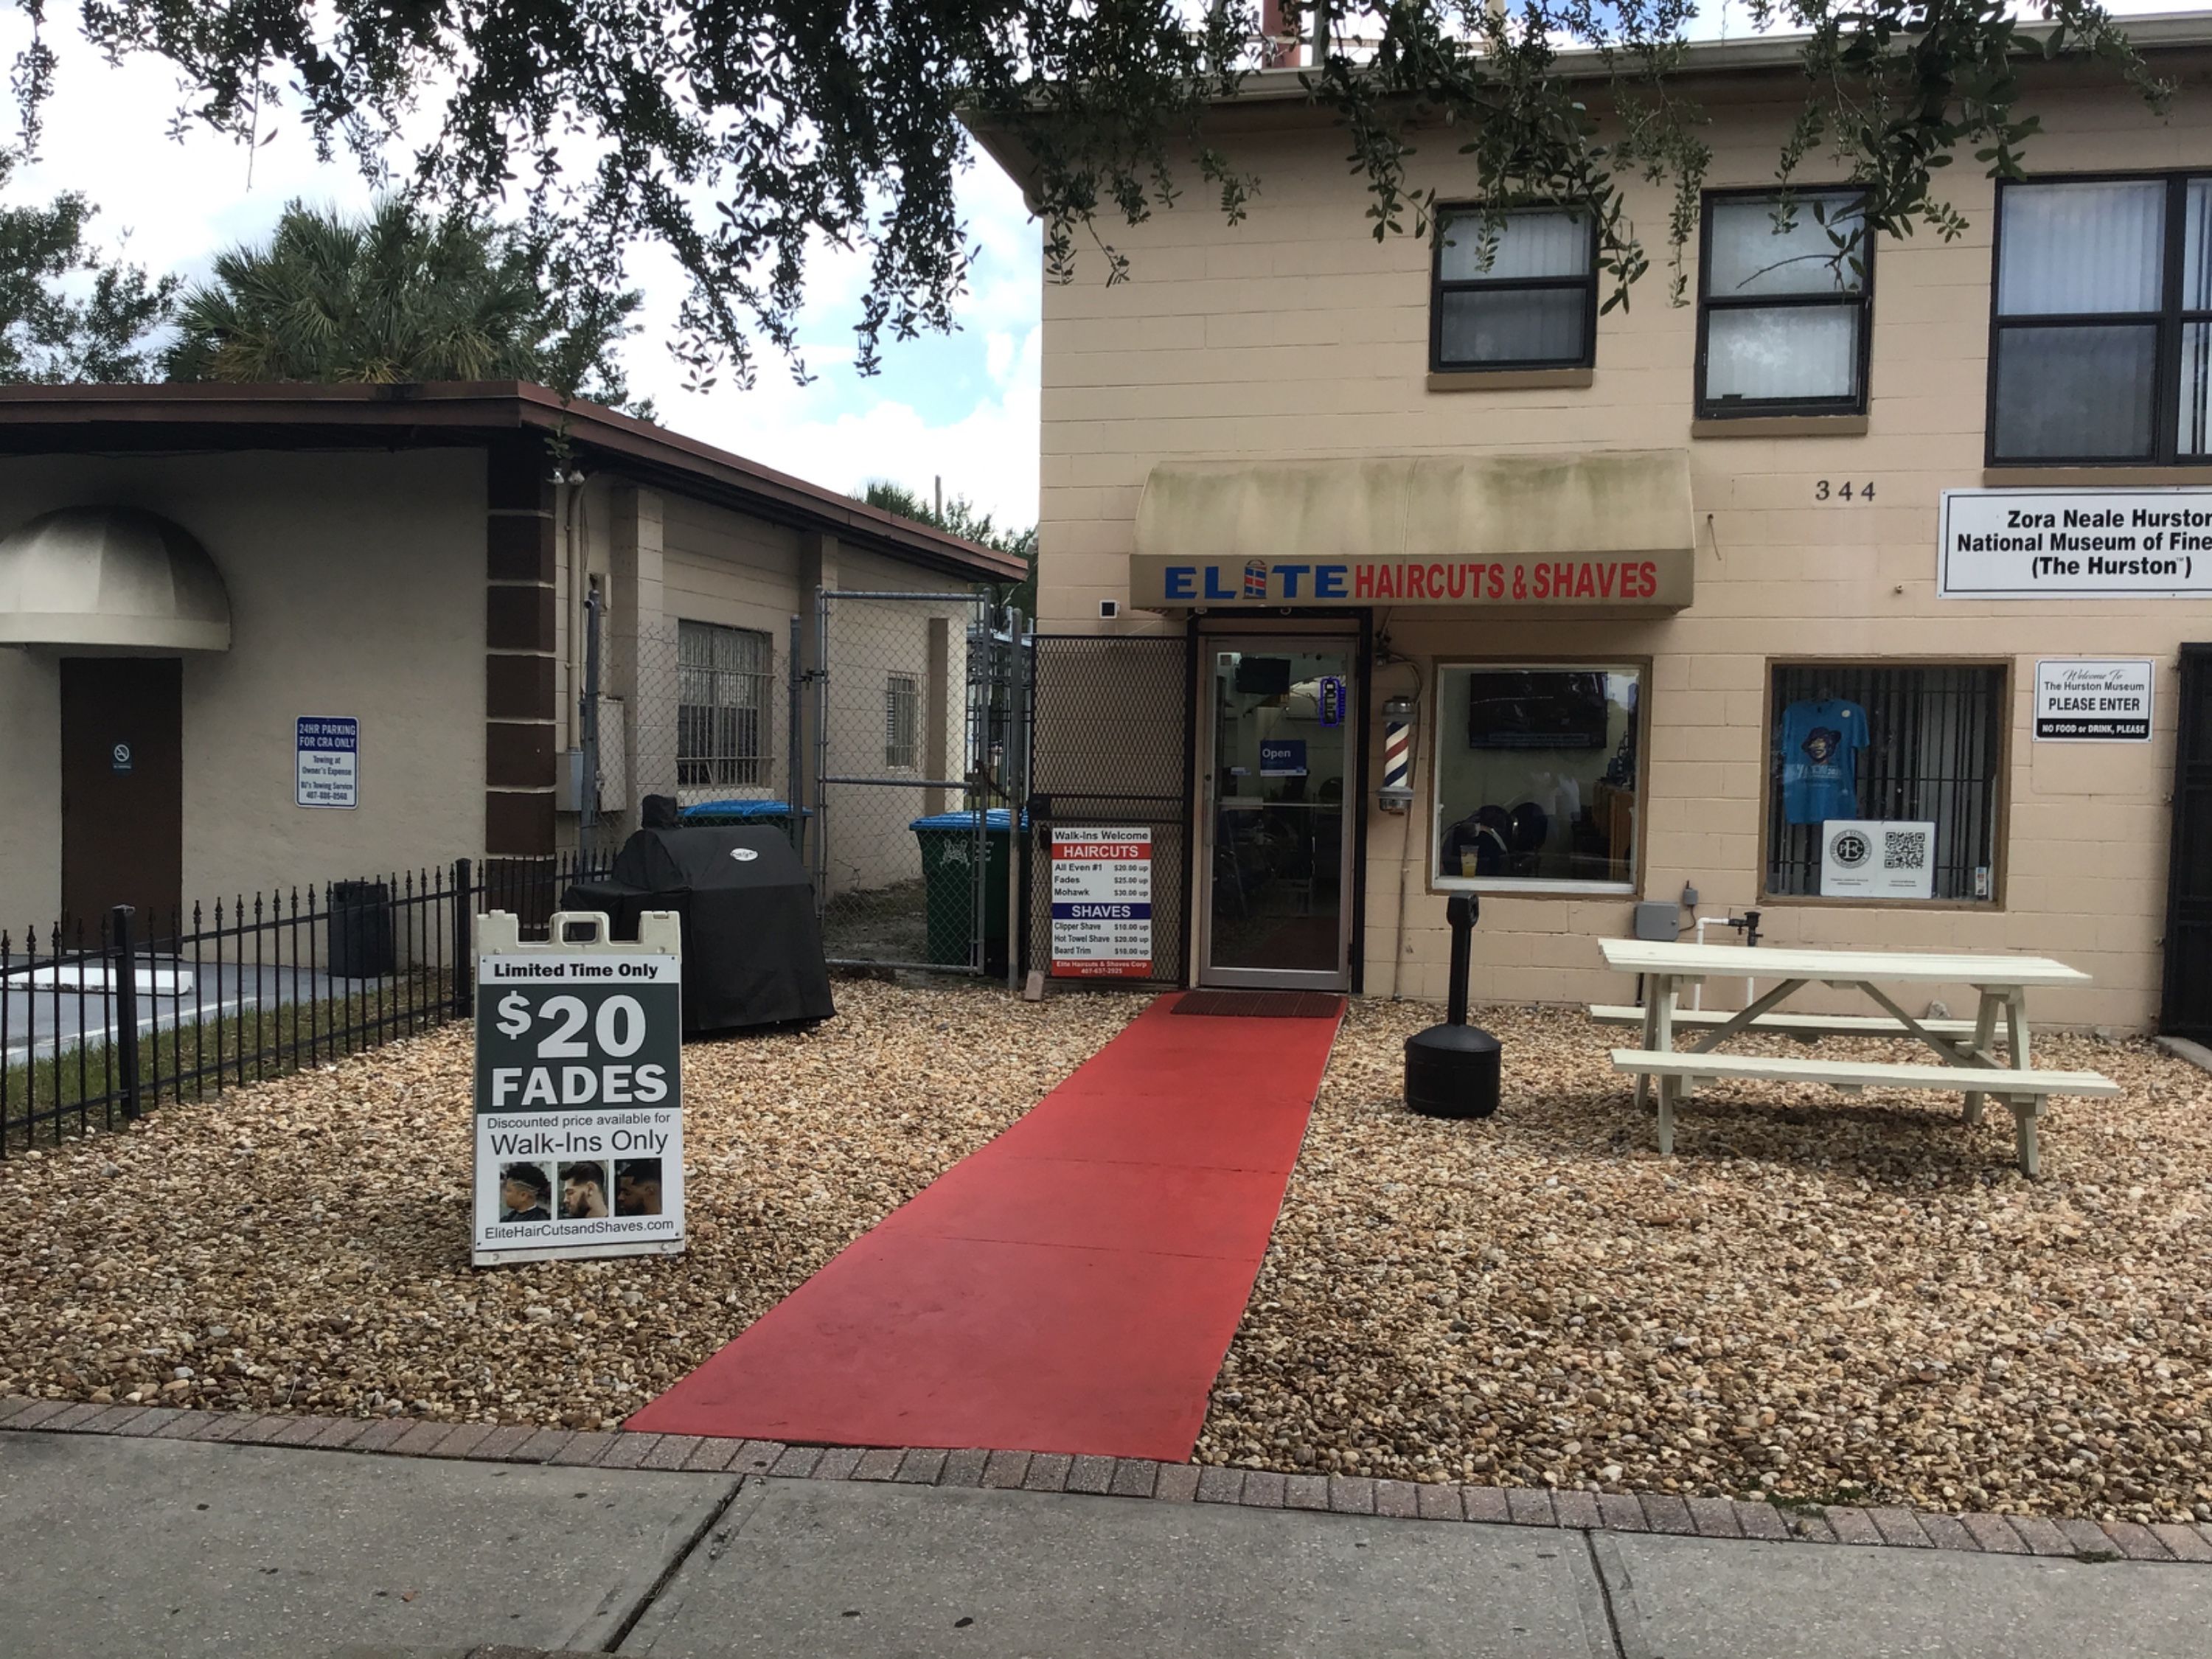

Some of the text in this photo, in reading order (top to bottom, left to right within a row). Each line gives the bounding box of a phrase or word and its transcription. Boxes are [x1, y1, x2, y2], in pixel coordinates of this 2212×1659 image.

[1815, 480, 1876, 501] 344
[2007, 510, 2055, 528] Zora
[2063, 509, 2124, 528] Neale
[1957, 531, 2212, 552] National Museum of Fine
[2032, 557, 2080, 578] (The
[1355, 563, 1504, 599] HAIRCUTS
[1512, 565, 1527, 599] &
[1533, 561, 1657, 598] SHAVES
[2062, 669, 2126, 681] Welcome To
[2044, 681, 2145, 691] The Hurston Museum
[2049, 698, 2140, 711] PLEASE ENTER
[299, 723, 355, 735] 24HR PARKING
[2042, 725, 2054, 733] NO
[2056, 725, 2077, 733] FOOD
[2088, 725, 2115, 734] DRINK,
[2116, 725, 2146, 734] PLEASE
[299, 736, 355, 748] FOR CRA ONLY
[1262, 748, 1291, 759] Open
[313, 755, 334, 765] Towing
[302, 765, 352, 776] Owner's Expense
[1054, 830, 1148, 840] Walk-Ins Welcome
[1063, 846, 1139, 858] HAIRCUTS
[1071, 905, 1131, 917] SHAVES
[1054, 922, 1079, 932] Clipper
[1080, 922, 1101, 931] Shave
[494, 963, 658, 979] Limited Time Only
[495, 990, 646, 1059] $20
[492, 1063, 668, 1107] FADES
[487, 1113, 670, 1130] Discounted price available for
[490, 1129, 668, 1155] Walk-Ins Only
[484, 1219, 674, 1239] EliteHairCutsandShaves.com
